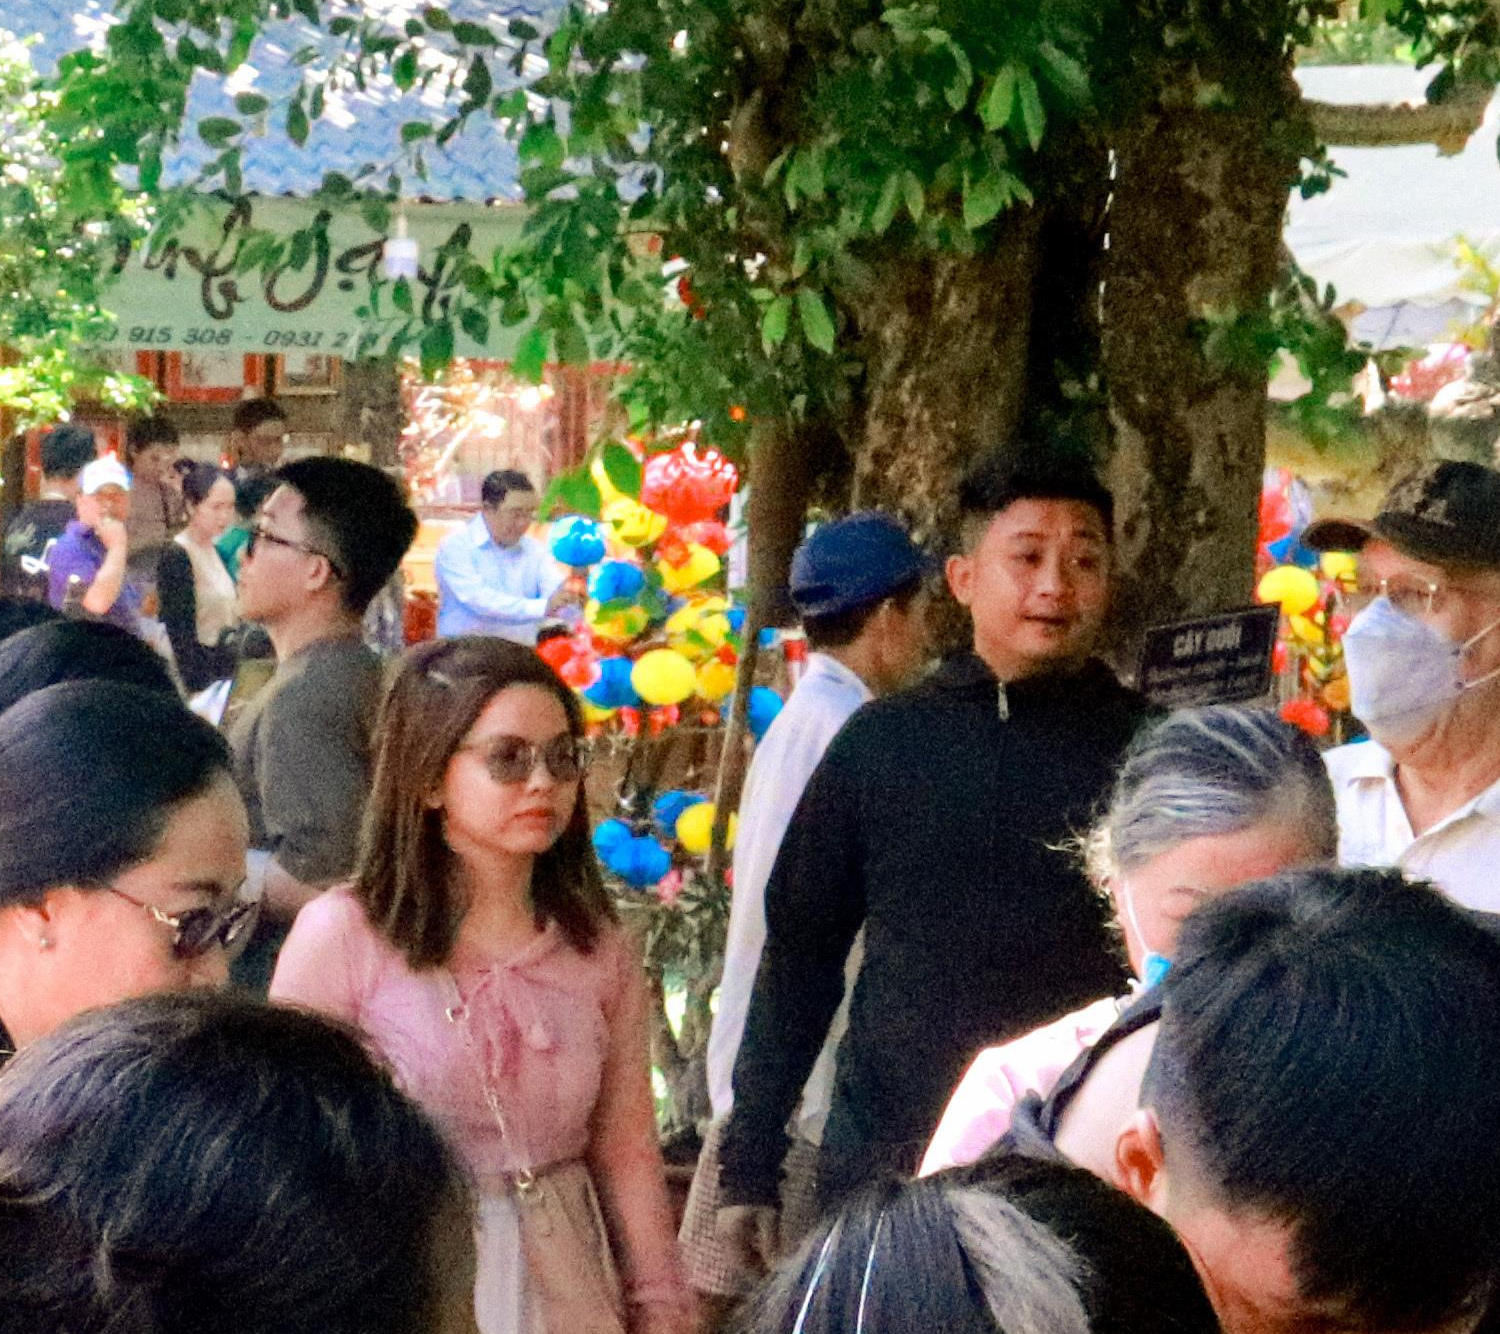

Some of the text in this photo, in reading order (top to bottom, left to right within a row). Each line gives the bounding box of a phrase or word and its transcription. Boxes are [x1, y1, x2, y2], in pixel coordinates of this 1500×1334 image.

[128, 326, 172, 344] 915
[183, 327, 233, 346] 308
[263, 329, 323, 348] 0931
